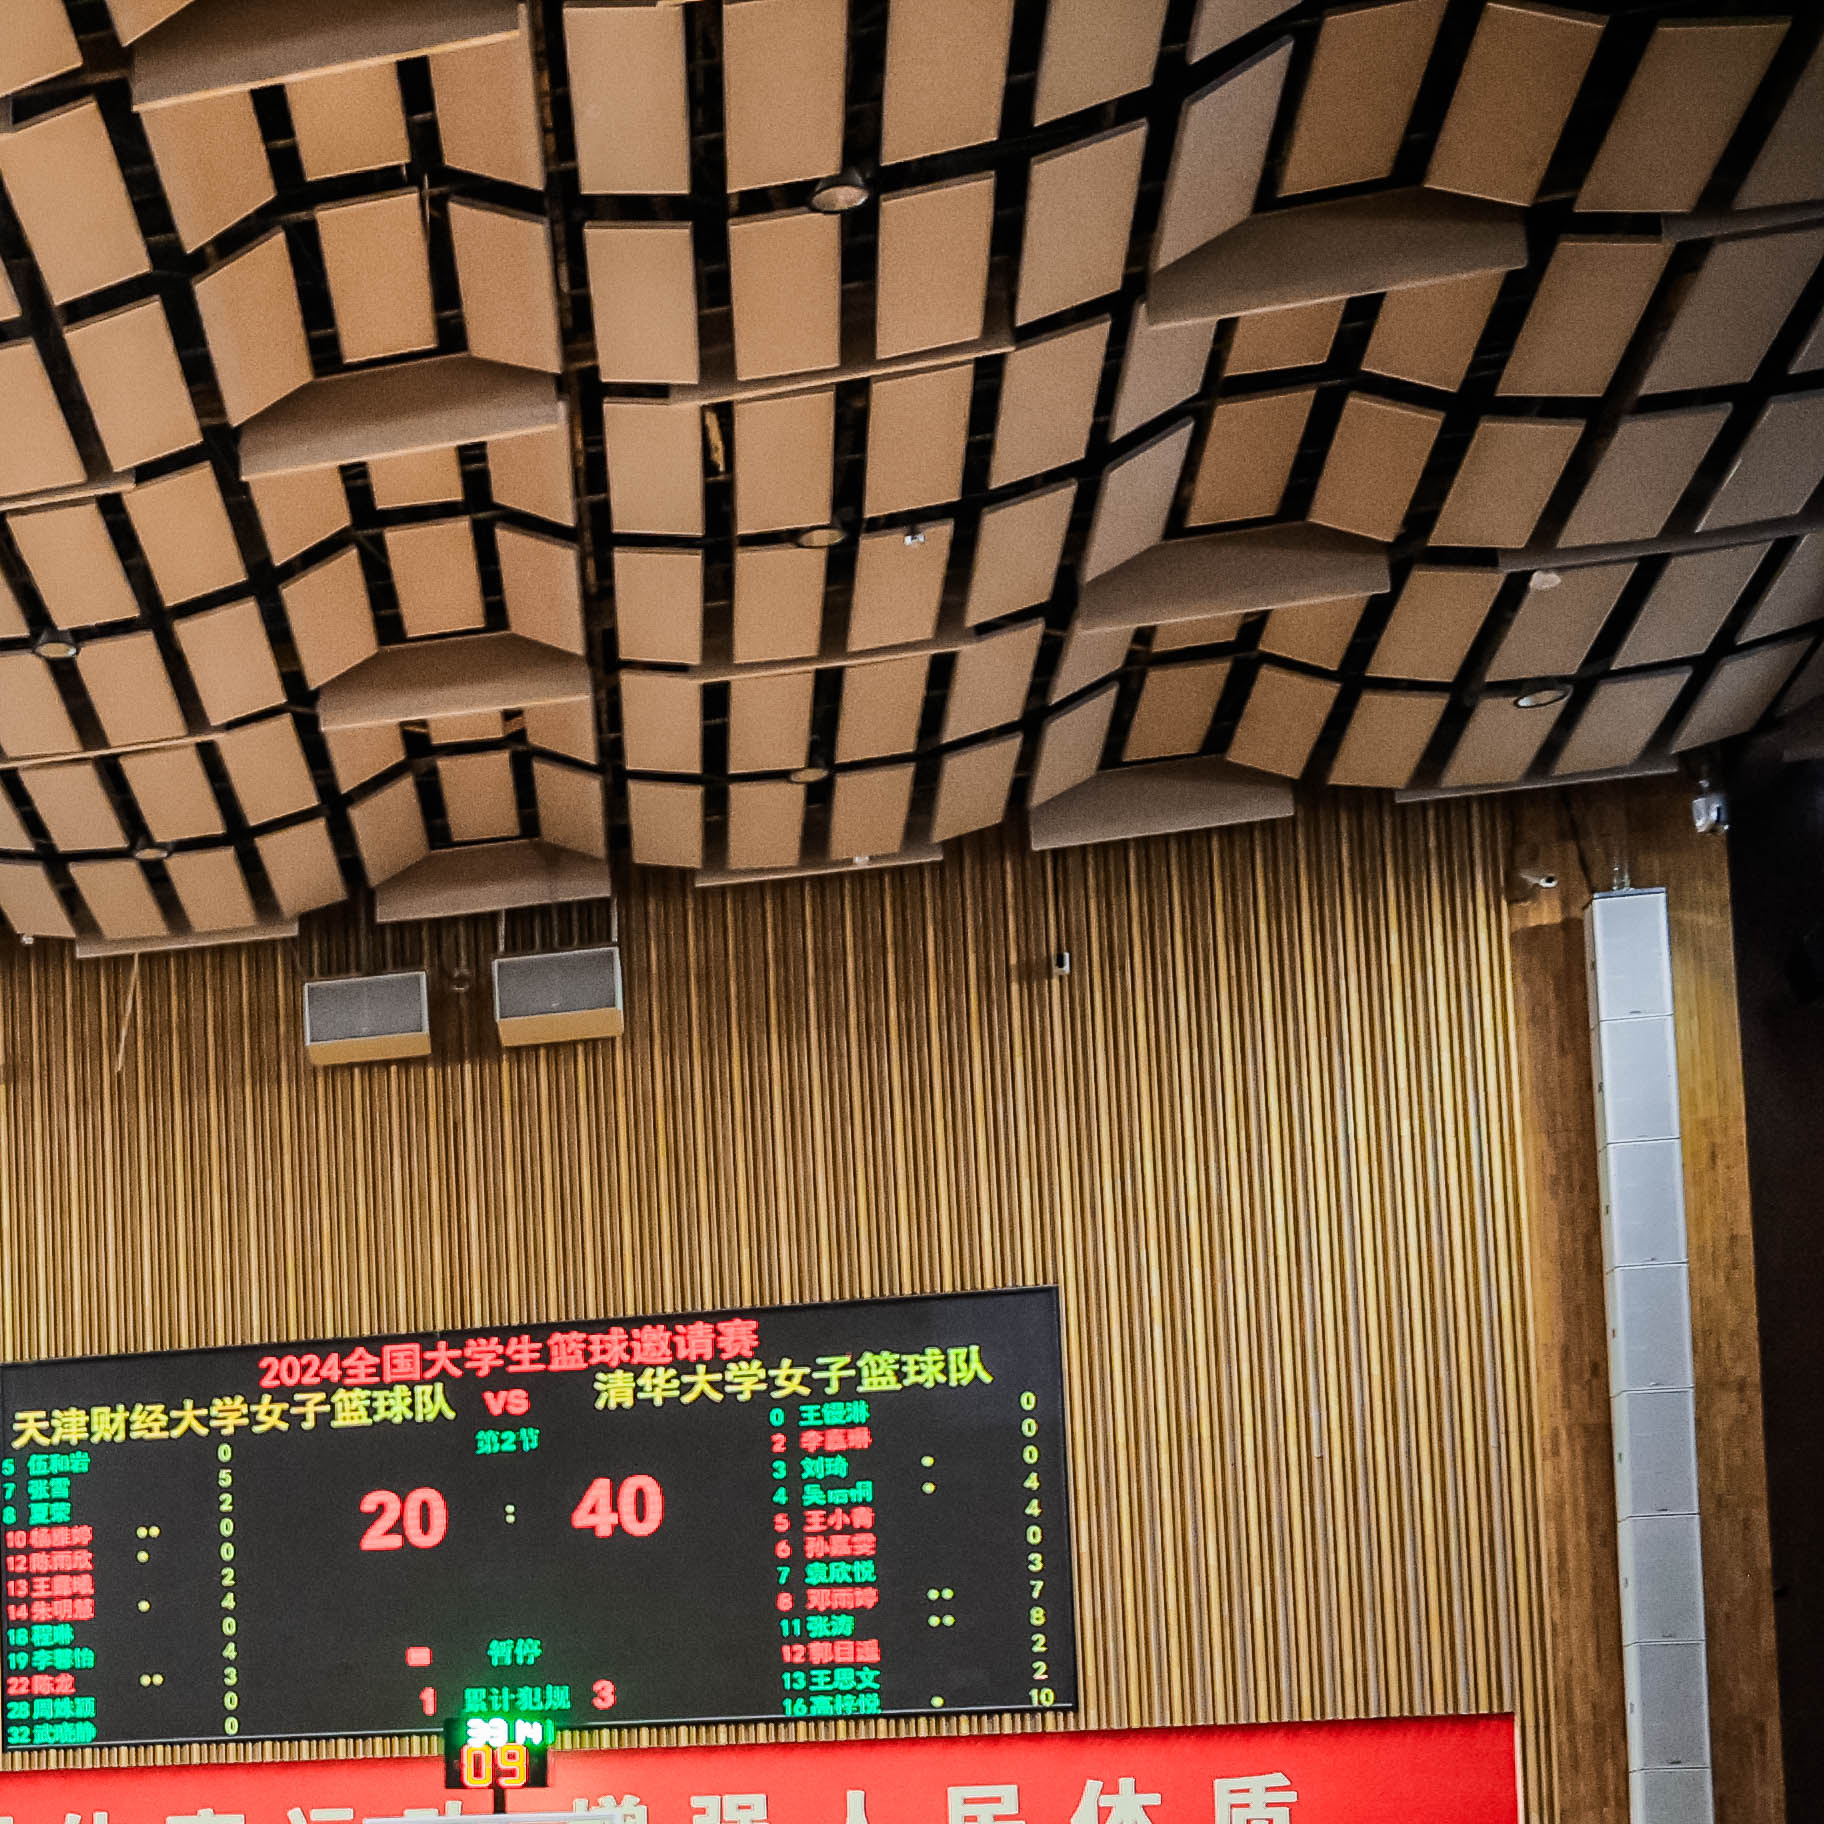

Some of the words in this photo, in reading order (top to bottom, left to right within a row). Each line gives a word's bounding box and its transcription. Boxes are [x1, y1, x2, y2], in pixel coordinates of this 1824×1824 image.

[258, 1319, 759, 1388] 2024全国大学生篮球邀请赛
[594, 1344, 993, 1411] 清华大学女子篮球队
[12, 1383, 456, 1449] 天津财经大学女子篮球队
[769, 1408, 785, 1427] 0
[1019, 1391, 1037, 1411] 0
[771, 1433, 787, 1453] 2
[1021, 1417, 1038, 1438] 0
[2, 1458, 15, 1476] 5
[217, 1443, 232, 1462] 0
[772, 1460, 787, 1479] 3
[1022, 1444, 1039, 1464] 0
[3, 1482, 15, 1500] 7
[218, 1469, 232, 1488] 5
[772, 1487, 788, 1505] 4
[1023, 1472, 1040, 1491] 4
[2, 1506, 16, 1525] 8
[218, 1493, 233, 1512] 2
[359, 1487, 449, 1551] 20
[571, 1474, 664, 1537] 40
[773, 1513, 790, 1533] 5
[1024, 1499, 1042, 1518] 4
[5, 1530, 27, 1548] 10
[219, 1517, 234, 1537] 0
[775, 1539, 792, 1559] 6
[1026, 1525, 1043, 1545] 0
[6, 1554, 28, 1573] 12
[220, 1542, 235, 1562] 0
[776, 1566, 790, 1585] 7
[1027, 1552, 1044, 1573] 3
[6, 1579, 29, 1597] 13
[220, 1567, 236, 1587] 2
[776, 1592, 794, 1612] 8
[1029, 1579, 1044, 1600] 7
[6, 1603, 29, 1621] 14
[220, 1591, 236, 1611] 4
[779, 1618, 801, 1638] 11
[1029, 1606, 1046, 1627] 8
[7, 1628, 29, 1646] 18
[221, 1616, 237, 1636] 0
[7, 1652, 29, 1670] 19
[222, 1641, 238, 1661] 4
[781, 1644, 806, 1664] 12
[1031, 1633, 1048, 1653] 2
[6, 1676, 30, 1695] 22
[223, 1666, 238, 1686] 3
[781, 1670, 806, 1691] 13
[808, 1665, 881, 1692] 王思文
[1031, 1660, 1049, 1680] 2
[6, 1701, 30, 1720] 28
[223, 1690, 239, 1711] 0
[592, 1679, 616, 1710] 3
[782, 1697, 807, 1717] 16
[1029, 1687, 1055, 1708] 10
[7, 1725, 31, 1744] 32
[224, 1716, 239, 1736] 0
[461, 1743, 529, 1788] 09
